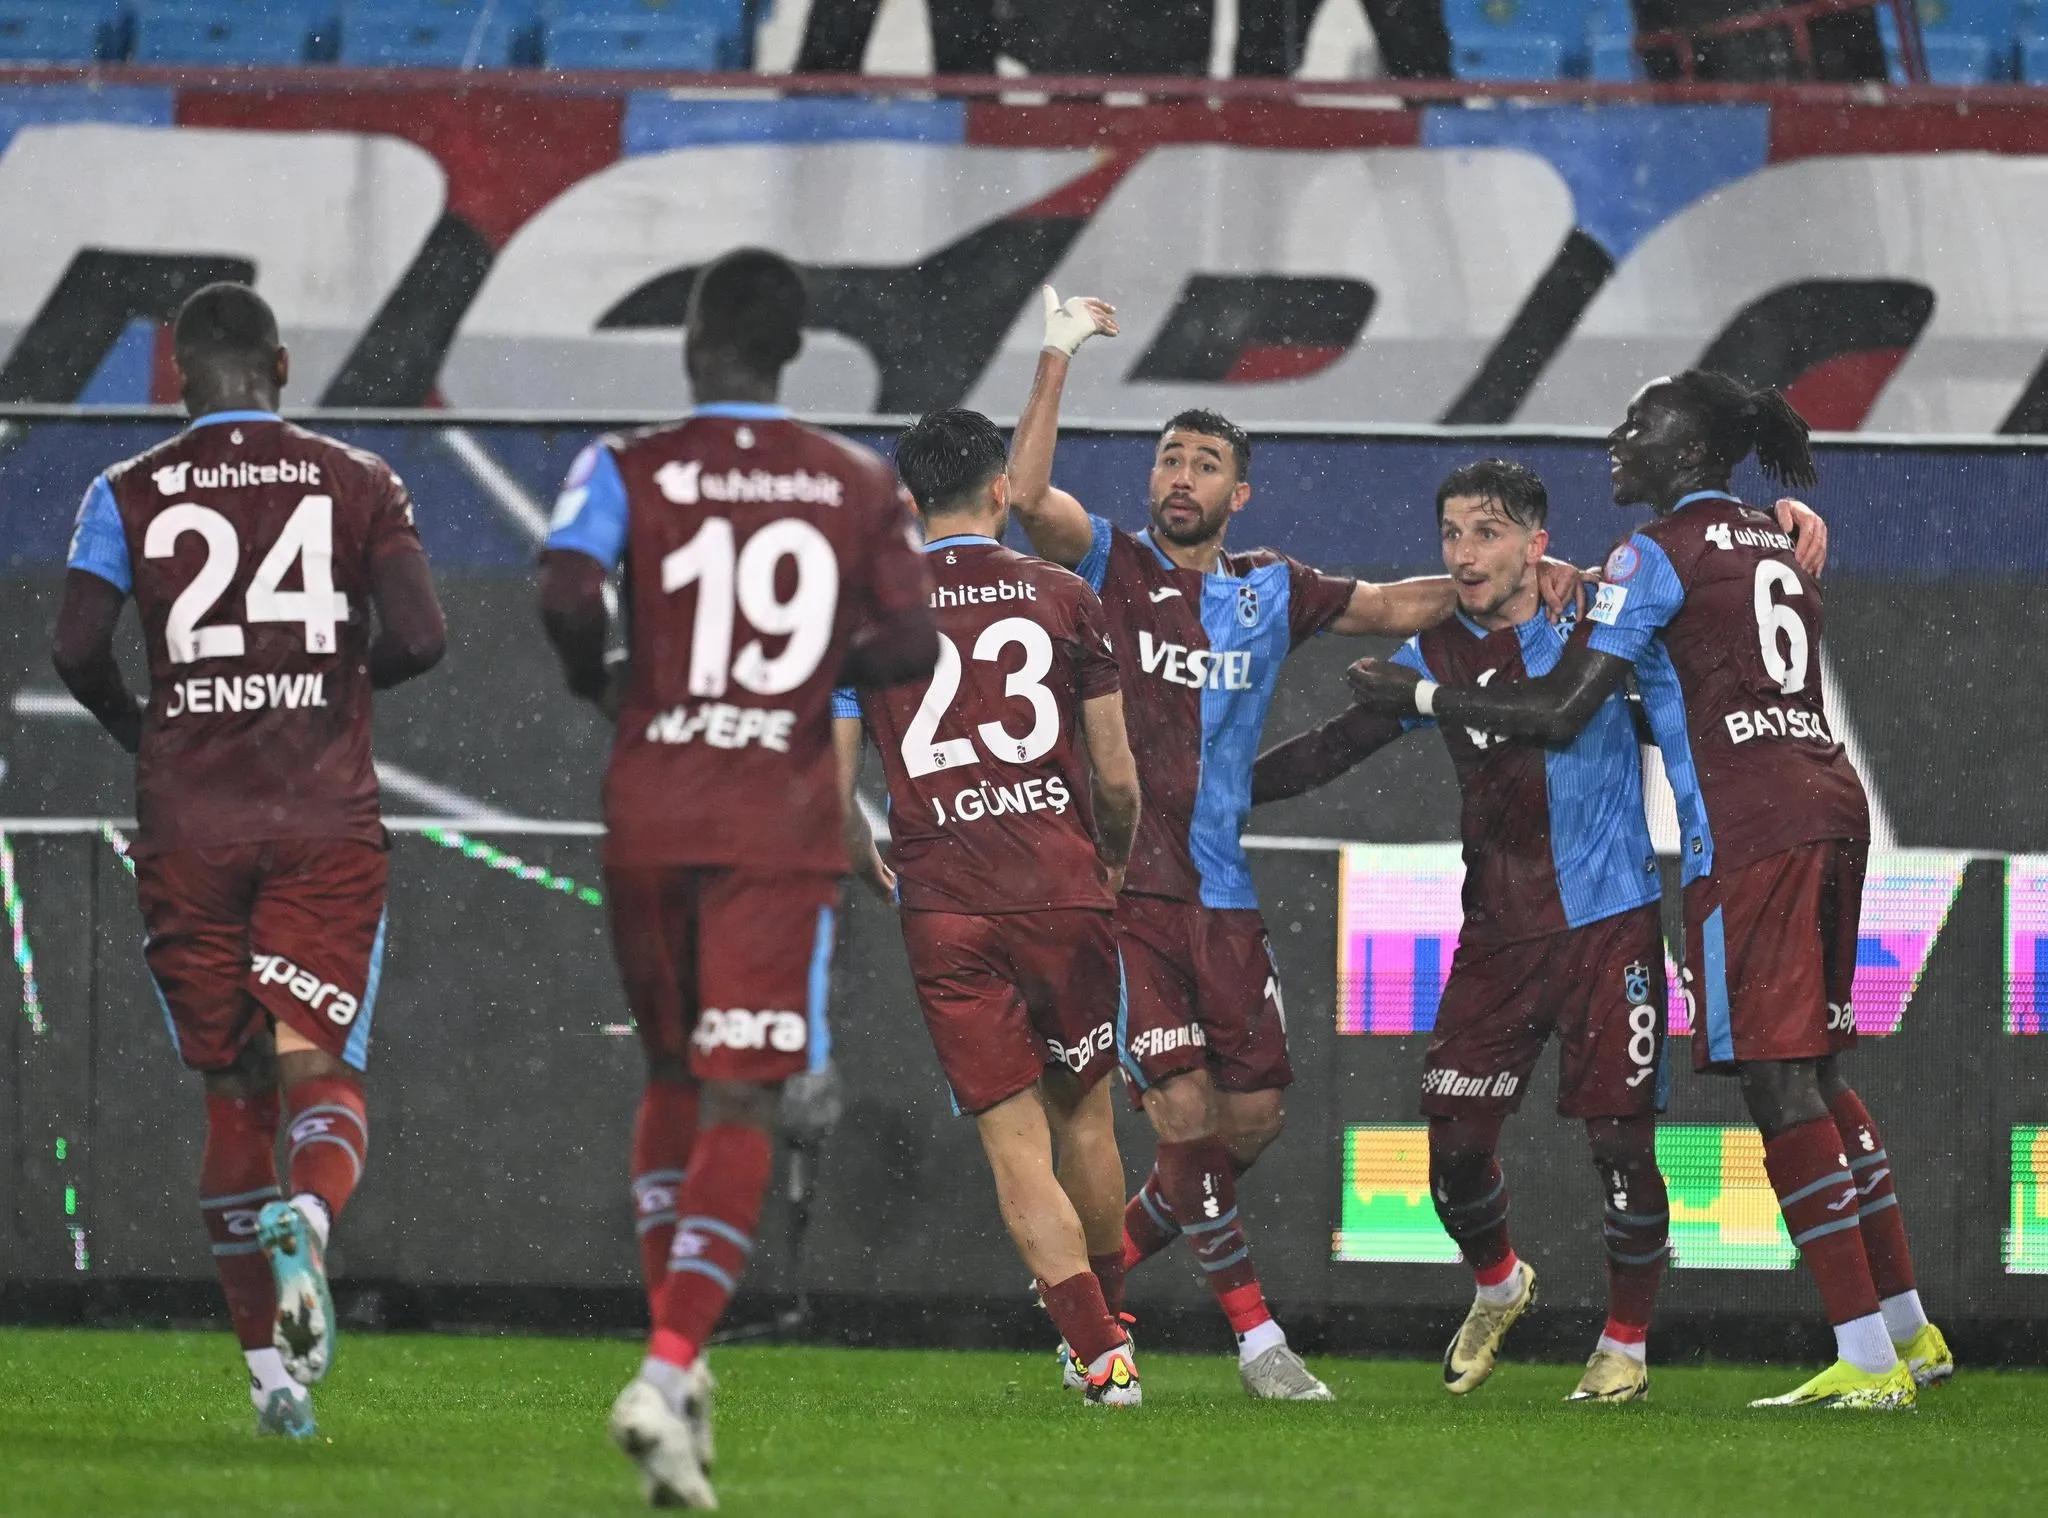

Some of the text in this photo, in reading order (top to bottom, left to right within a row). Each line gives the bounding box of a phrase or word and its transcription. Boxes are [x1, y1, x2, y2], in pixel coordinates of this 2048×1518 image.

[193, 458, 321, 488] whitebit
[1734, 527, 1796, 552] whiteb
[144, 495, 349, 663] 24
[661, 516, 839, 698] 19
[1754, 558, 1809, 695] 6
[1138, 631, 1253, 690] VESTEL
[901, 617, 1060, 779] 23
[931, 776, 1071, 826] J.GÜNEŞ
[1628, 1004, 1657, 1066] 8
[1436, 1069, 1519, 1097] Rent Go
